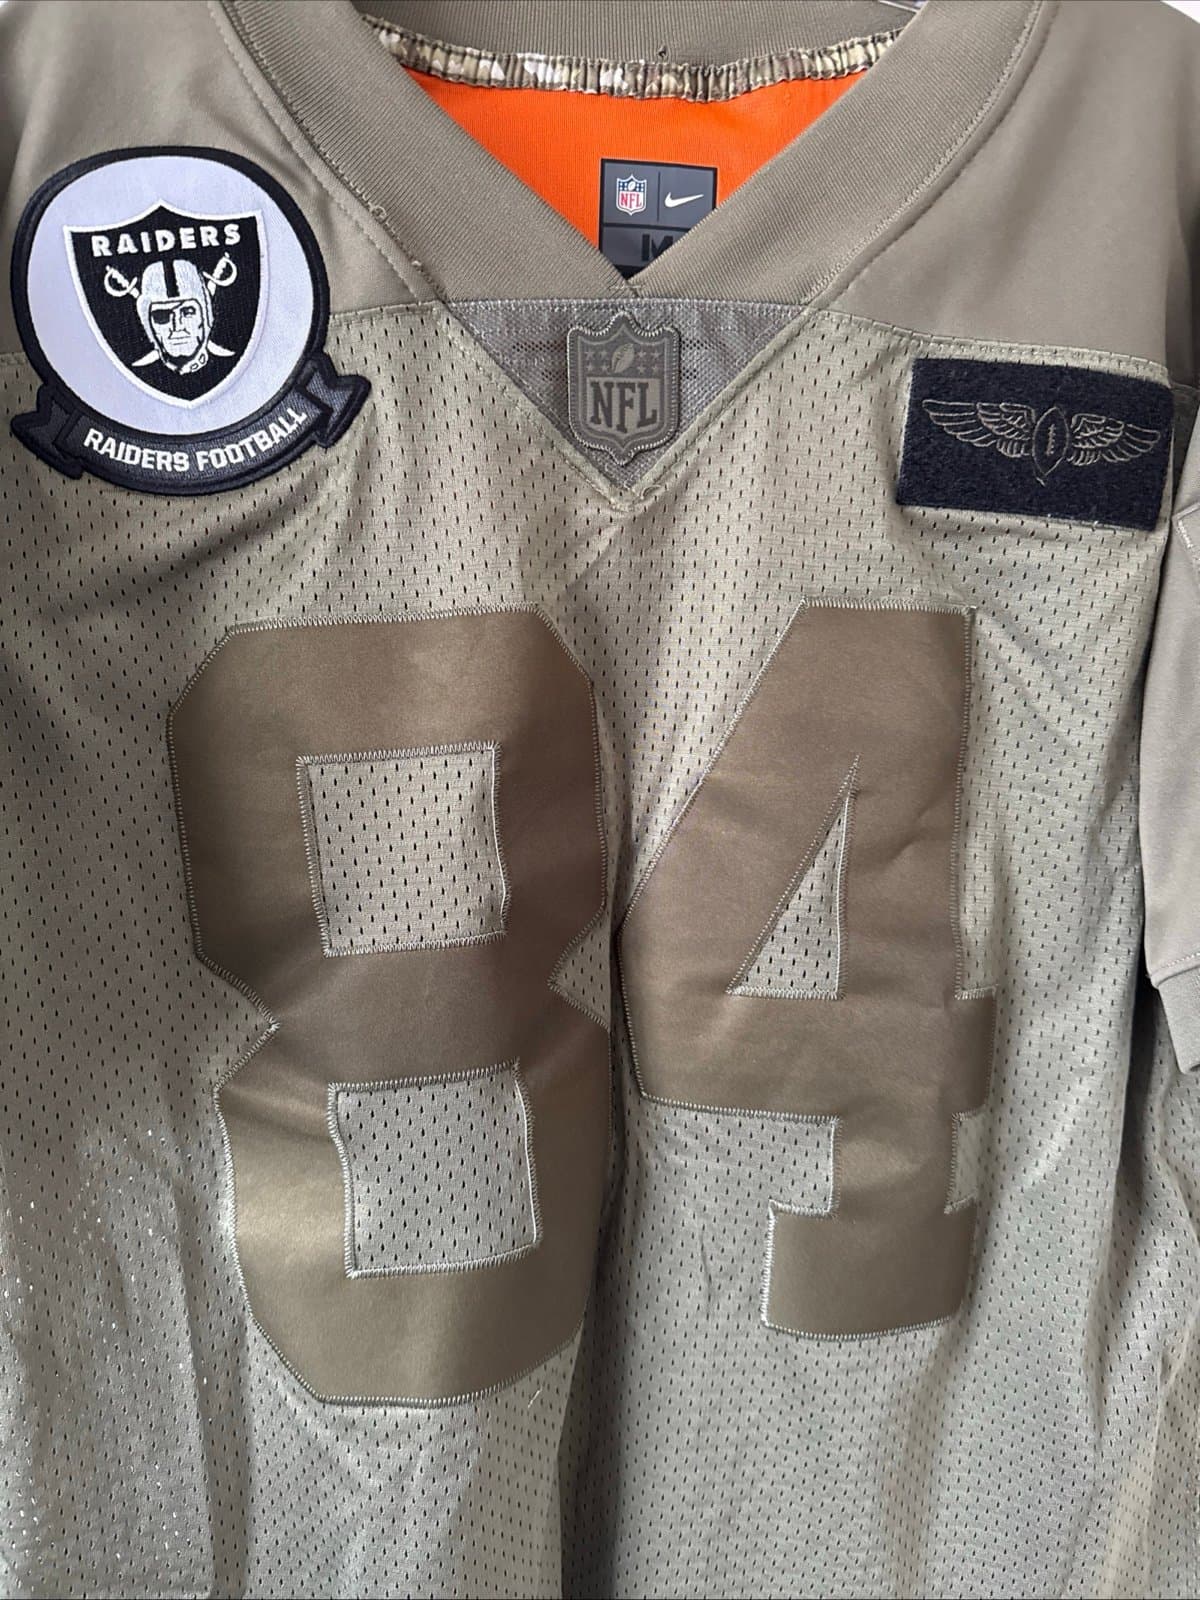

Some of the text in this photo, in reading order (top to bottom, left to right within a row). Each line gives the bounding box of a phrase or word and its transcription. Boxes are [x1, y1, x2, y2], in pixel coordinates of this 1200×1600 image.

[620, 192, 642, 209] NFL
[91, 223, 241, 257] RAIDERS
[590, 381, 658, 434] NFL
[84, 407, 308, 472] RAIDERS FOOTBALL
[166, 599, 997, 1406] 84
